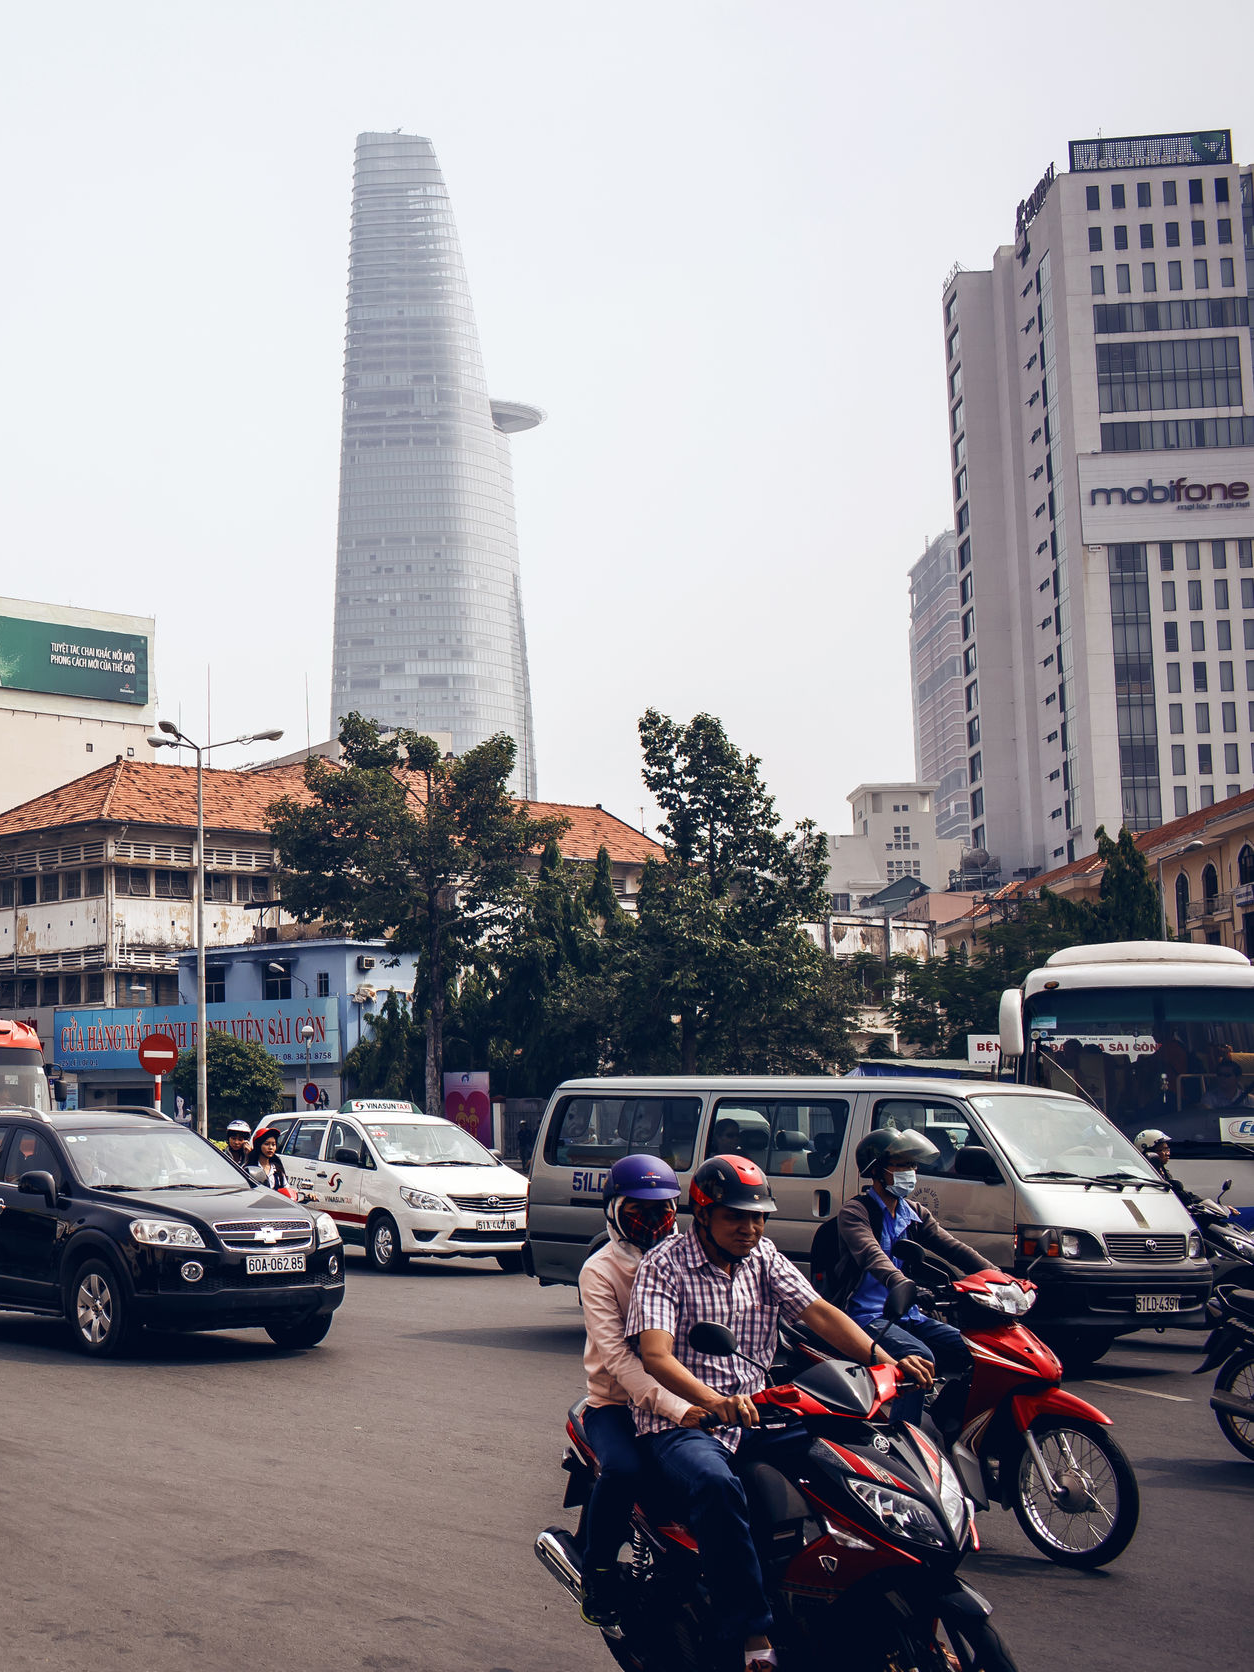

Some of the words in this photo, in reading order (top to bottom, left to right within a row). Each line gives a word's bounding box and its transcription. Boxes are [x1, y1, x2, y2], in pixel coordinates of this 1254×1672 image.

[1079, 151, 1191, 170] Vietcombank
[1090, 477, 1250, 506] mobifone
[60, 1015, 85, 1053] CỬA
[87, 1017, 122, 1052] HÀNG
[268, 1008, 291, 1045] SÀI
[296, 1007, 326, 1045] GÒN
[976, 1040, 1001, 1053] BỆN
[1108, 1041, 1129, 1052] SÀI
[314, 1051, 332, 1060] 8758
[248, 1256, 304, 1272] 60A-062.85
